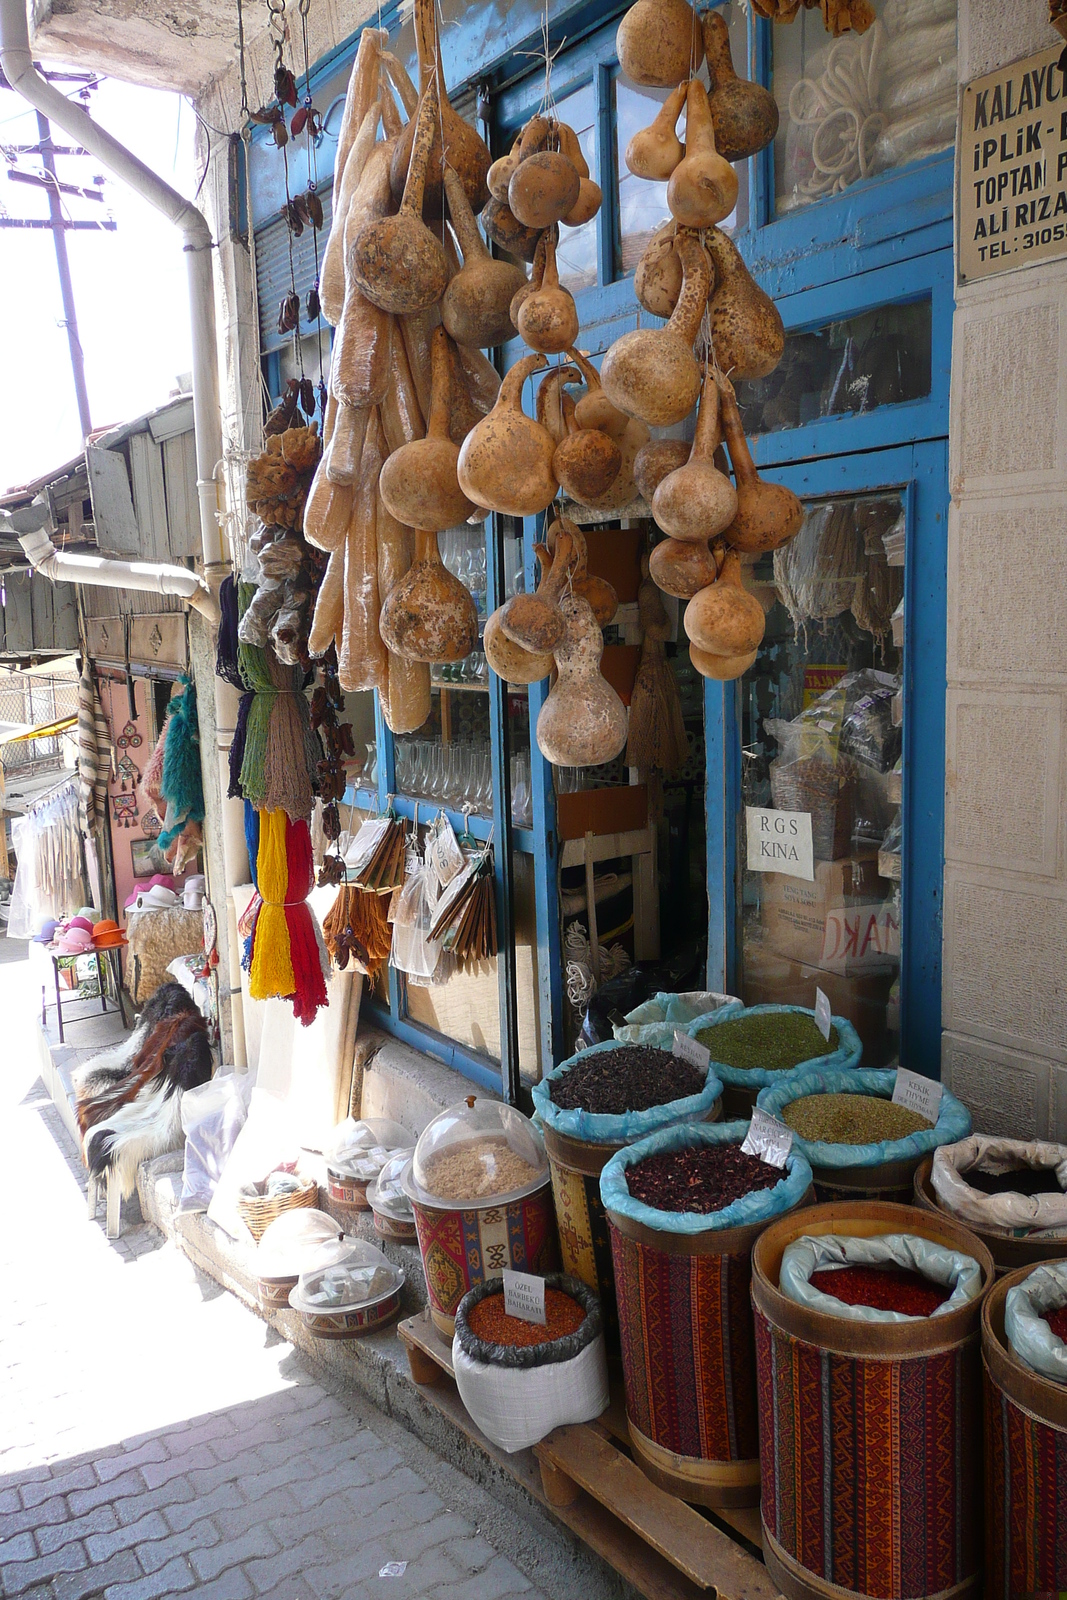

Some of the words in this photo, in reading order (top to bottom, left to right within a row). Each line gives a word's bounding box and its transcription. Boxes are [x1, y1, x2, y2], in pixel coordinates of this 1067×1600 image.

[973, 159, 1046, 209] TOPTAN
[973, 206, 1009, 241] ALİ
[1015, 191, 1067, 228] RIZA
[1023, 224, 1067, 250] 3105
[760, 841, 799, 861] KINA
[904, 1088, 930, 1106] THYME
[515, 1281, 532, 1293] ÖZEL
